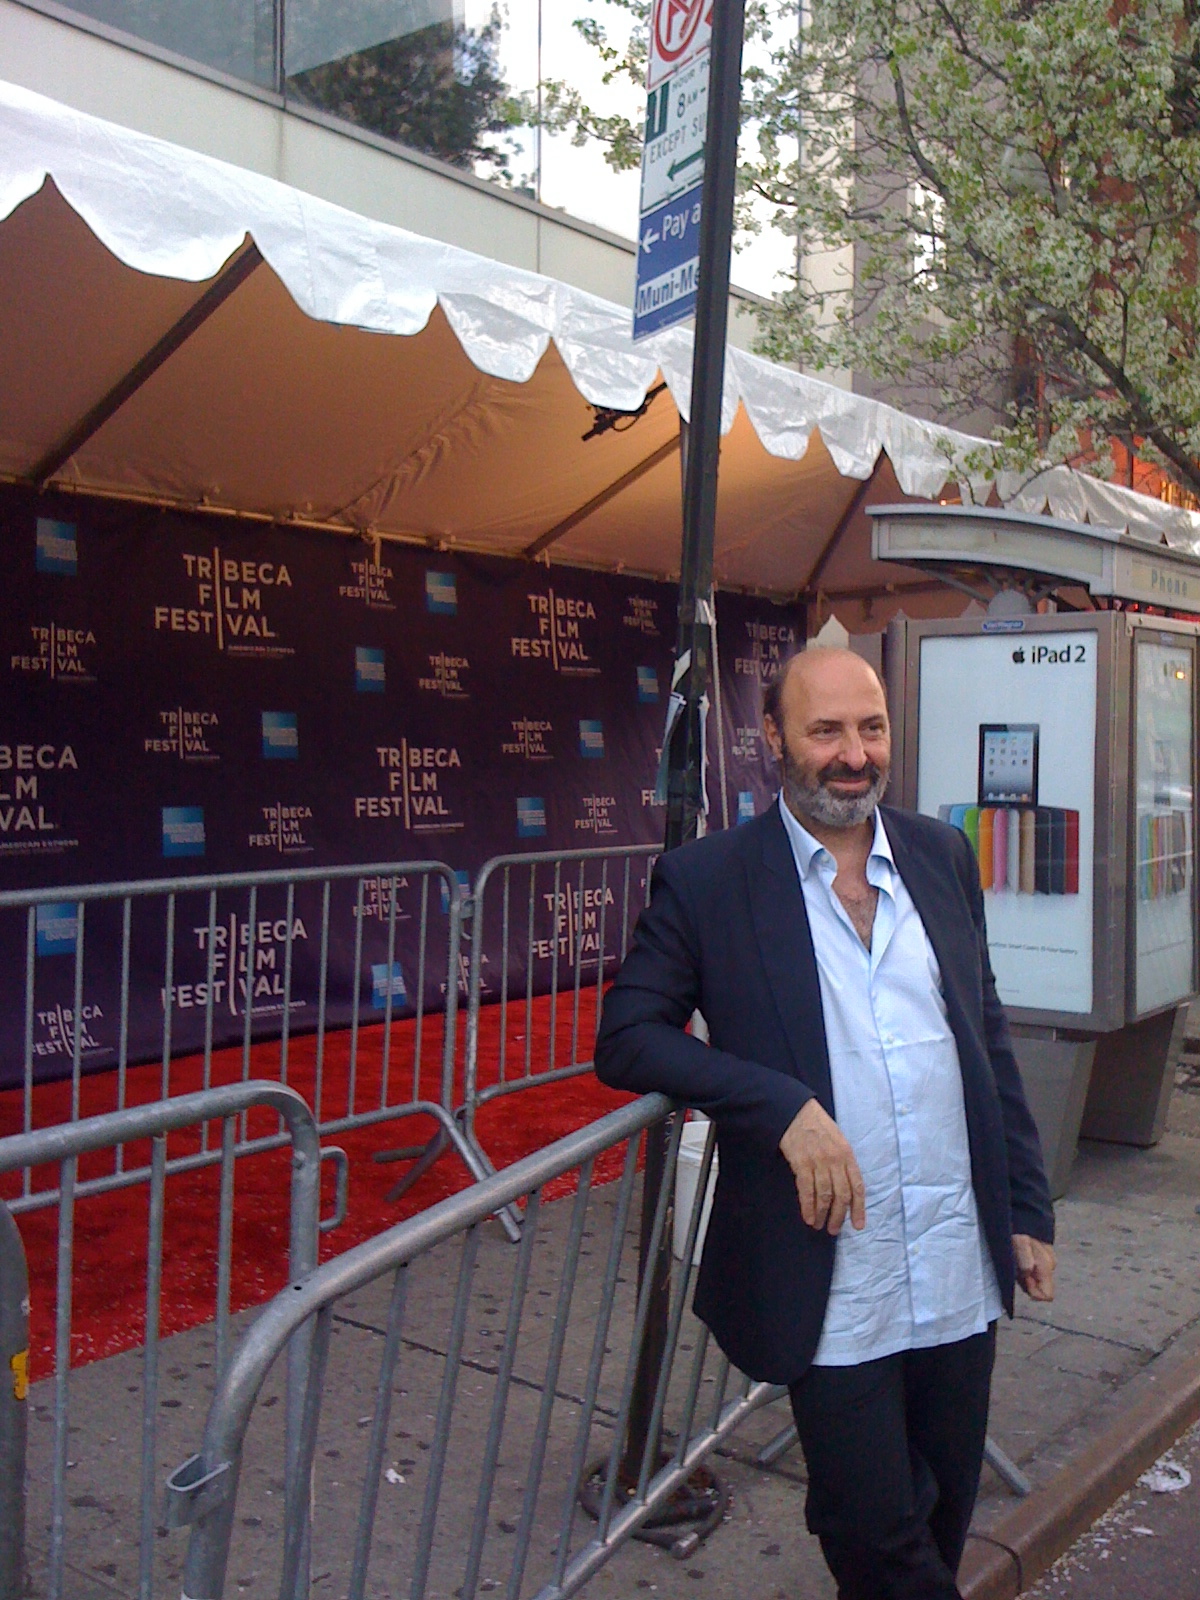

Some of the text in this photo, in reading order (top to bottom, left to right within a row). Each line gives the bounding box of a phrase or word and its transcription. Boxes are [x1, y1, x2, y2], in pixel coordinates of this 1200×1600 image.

[650, 125, 687, 164] EXCEPT
[662, 209, 689, 241] Pay
[183, 553, 292, 587] TRIBECA
[199, 583, 261, 611] FILM
[528, 595, 596, 619] TRIBECA
[155, 606, 276, 638] FESTIVAL
[539, 617, 579, 639] FILM
[31, 626, 96, 645] TRIBECA
[40, 640, 78, 657] FILM
[511, 638, 588, 661] FESTIVAL
[1031, 645, 1086, 664] iPad 2
[11, 656, 86, 673] FESTIVAL
[160, 711, 219, 725] TRIBECA
[169, 726, 203, 738] FILM
[145, 739, 210, 752] FESTIVAL
[377, 748, 461, 768] TRIBECA
[389, 772, 437, 791] FILM
[263, 807, 312, 820] TRIBECA
[355, 796, 448, 818] FESTIVAL
[270, 820, 299, 831] FILM
[249, 832, 306, 847] FESTIVAL
[37, 1005, 103, 1026] TRIBCA
